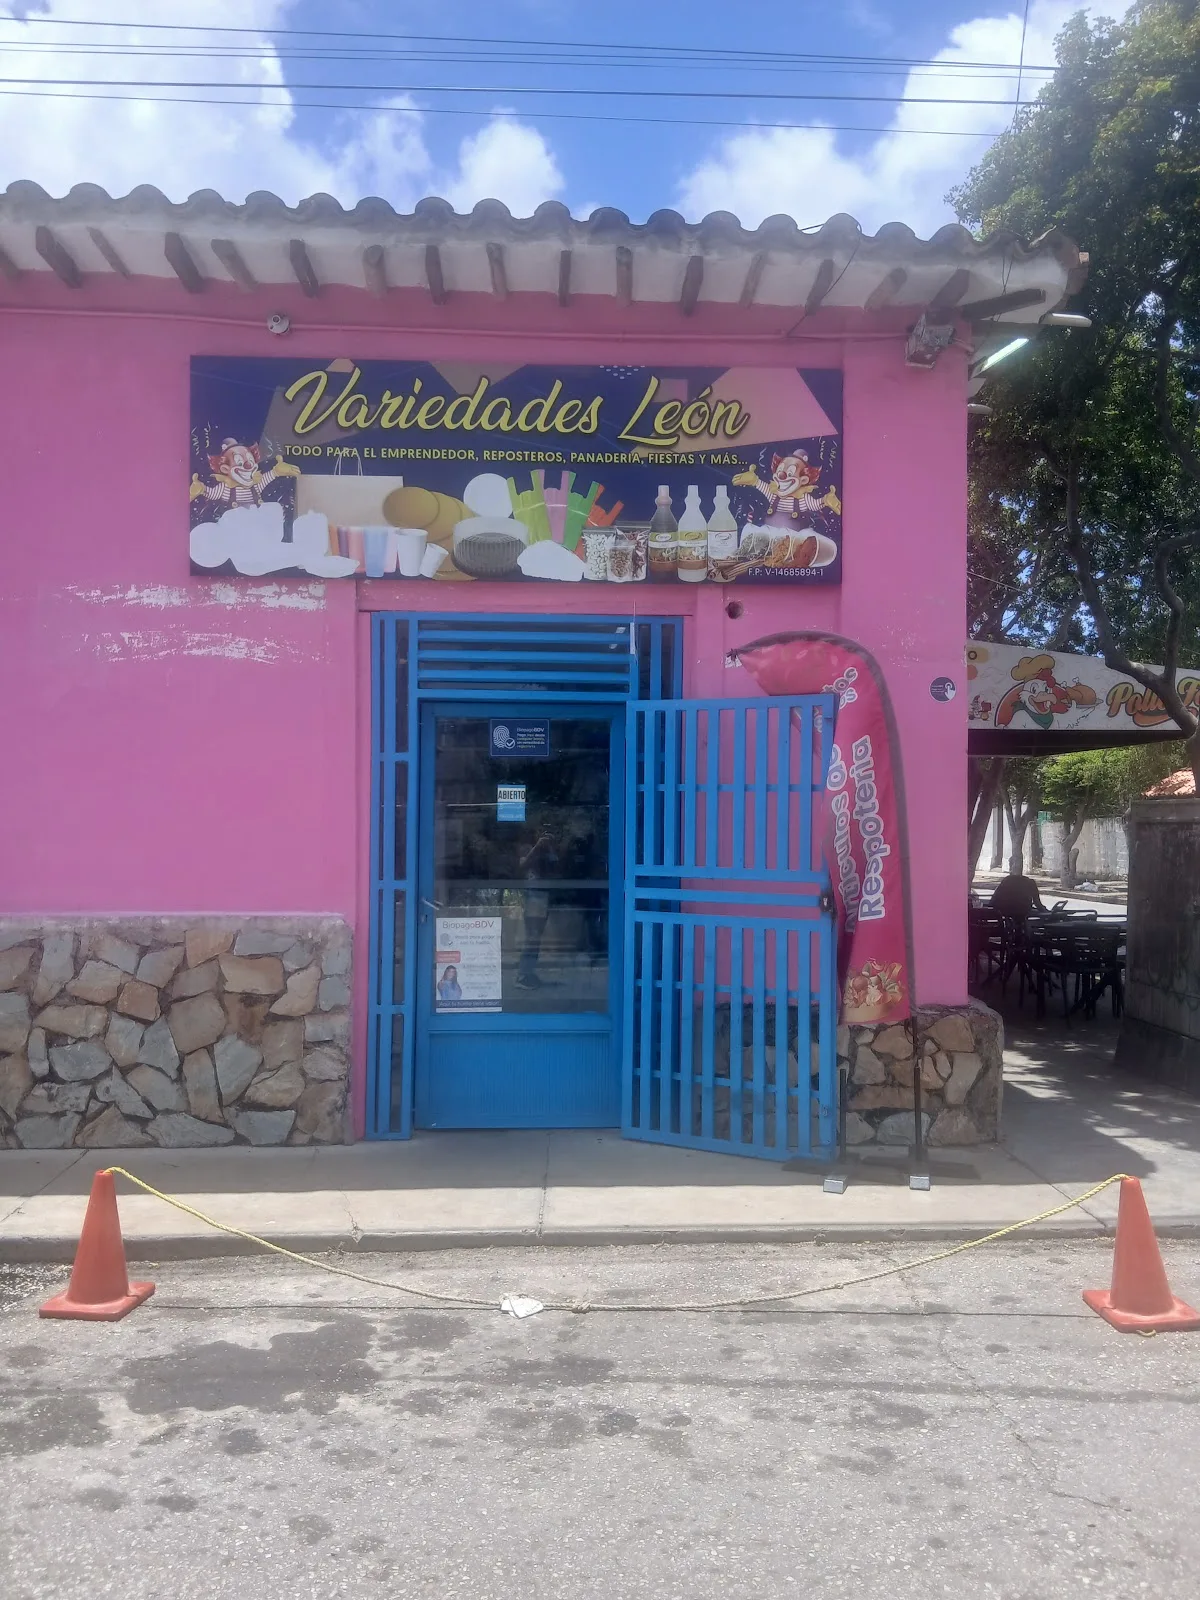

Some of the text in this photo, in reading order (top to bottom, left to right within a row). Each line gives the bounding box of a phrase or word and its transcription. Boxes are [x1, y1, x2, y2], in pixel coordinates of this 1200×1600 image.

[284, 366, 751, 446] Variedades León
[285, 445, 322, 457] TODO
[326, 446, 359, 459] PARA
[363, 447, 377, 459] EL
[381, 448, 480, 462] EMPRENDEDOR,
[483, 450, 567, 463] REPOSTEROS,
[648, 453, 695, 464] FIESTAS
[699, 453, 706, 465] Y
[764, 567, 824, 577] V-14685894-1
[497, 790, 526, 801] ABIERTO
[442, 920, 495, 930] BiopagoBDV
